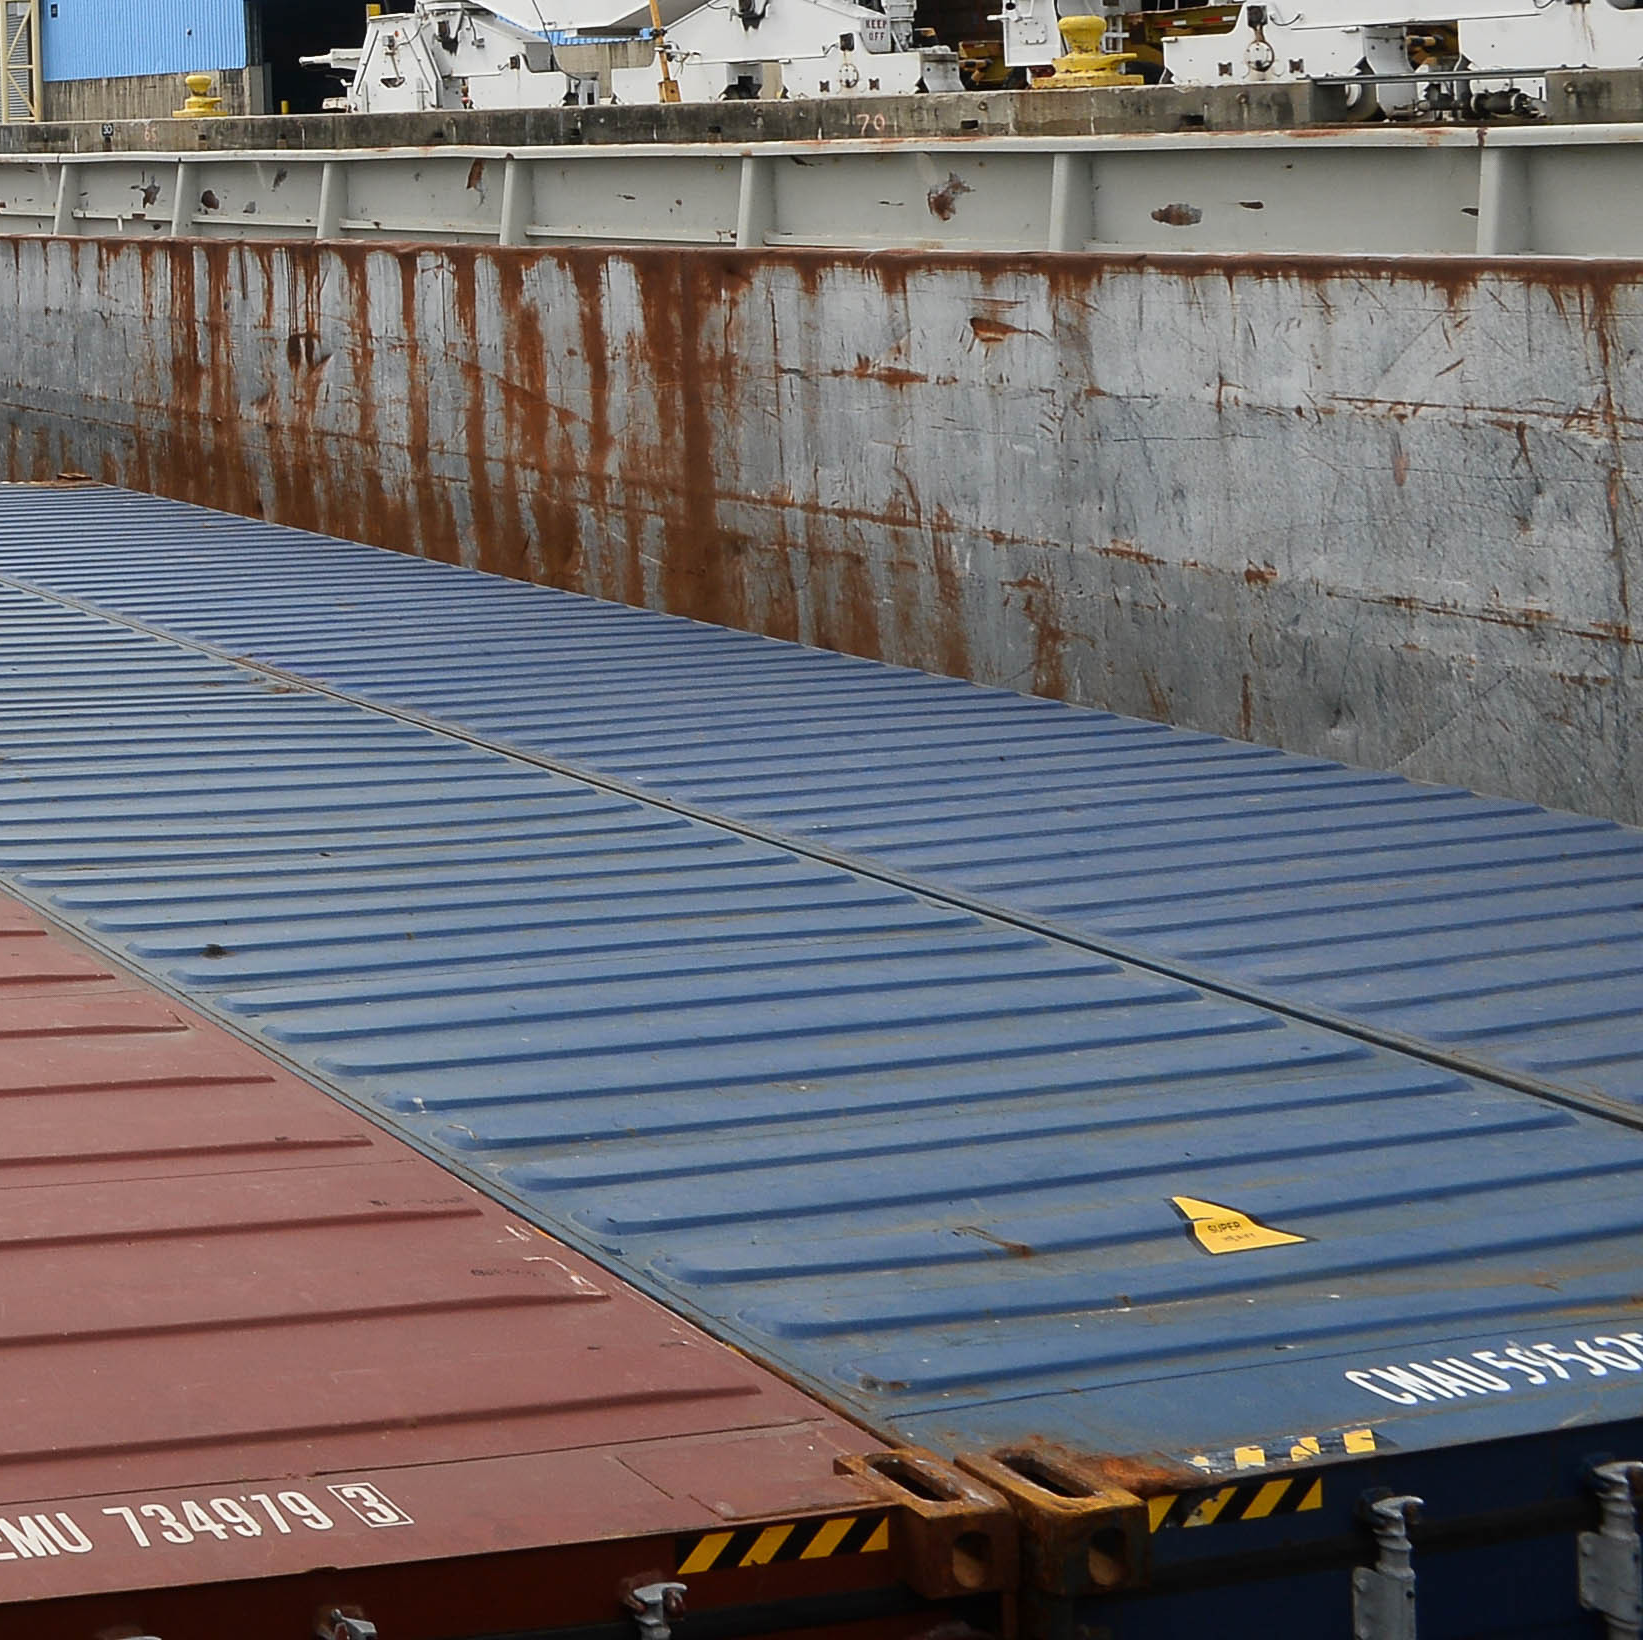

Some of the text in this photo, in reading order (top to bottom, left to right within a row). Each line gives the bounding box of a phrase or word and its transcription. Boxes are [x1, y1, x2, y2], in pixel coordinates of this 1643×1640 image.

[865, 19, 887, 29] KEEP
[868, 31, 885, 41] OFF
[856, 113, 885, 136] 70
[1207, 1220, 1242, 1234] SUPER
[1344, 1357, 1512, 1405] CMAU
[101, 1490, 334, 1548] 734979
[345, 1486, 401, 1524] 3
